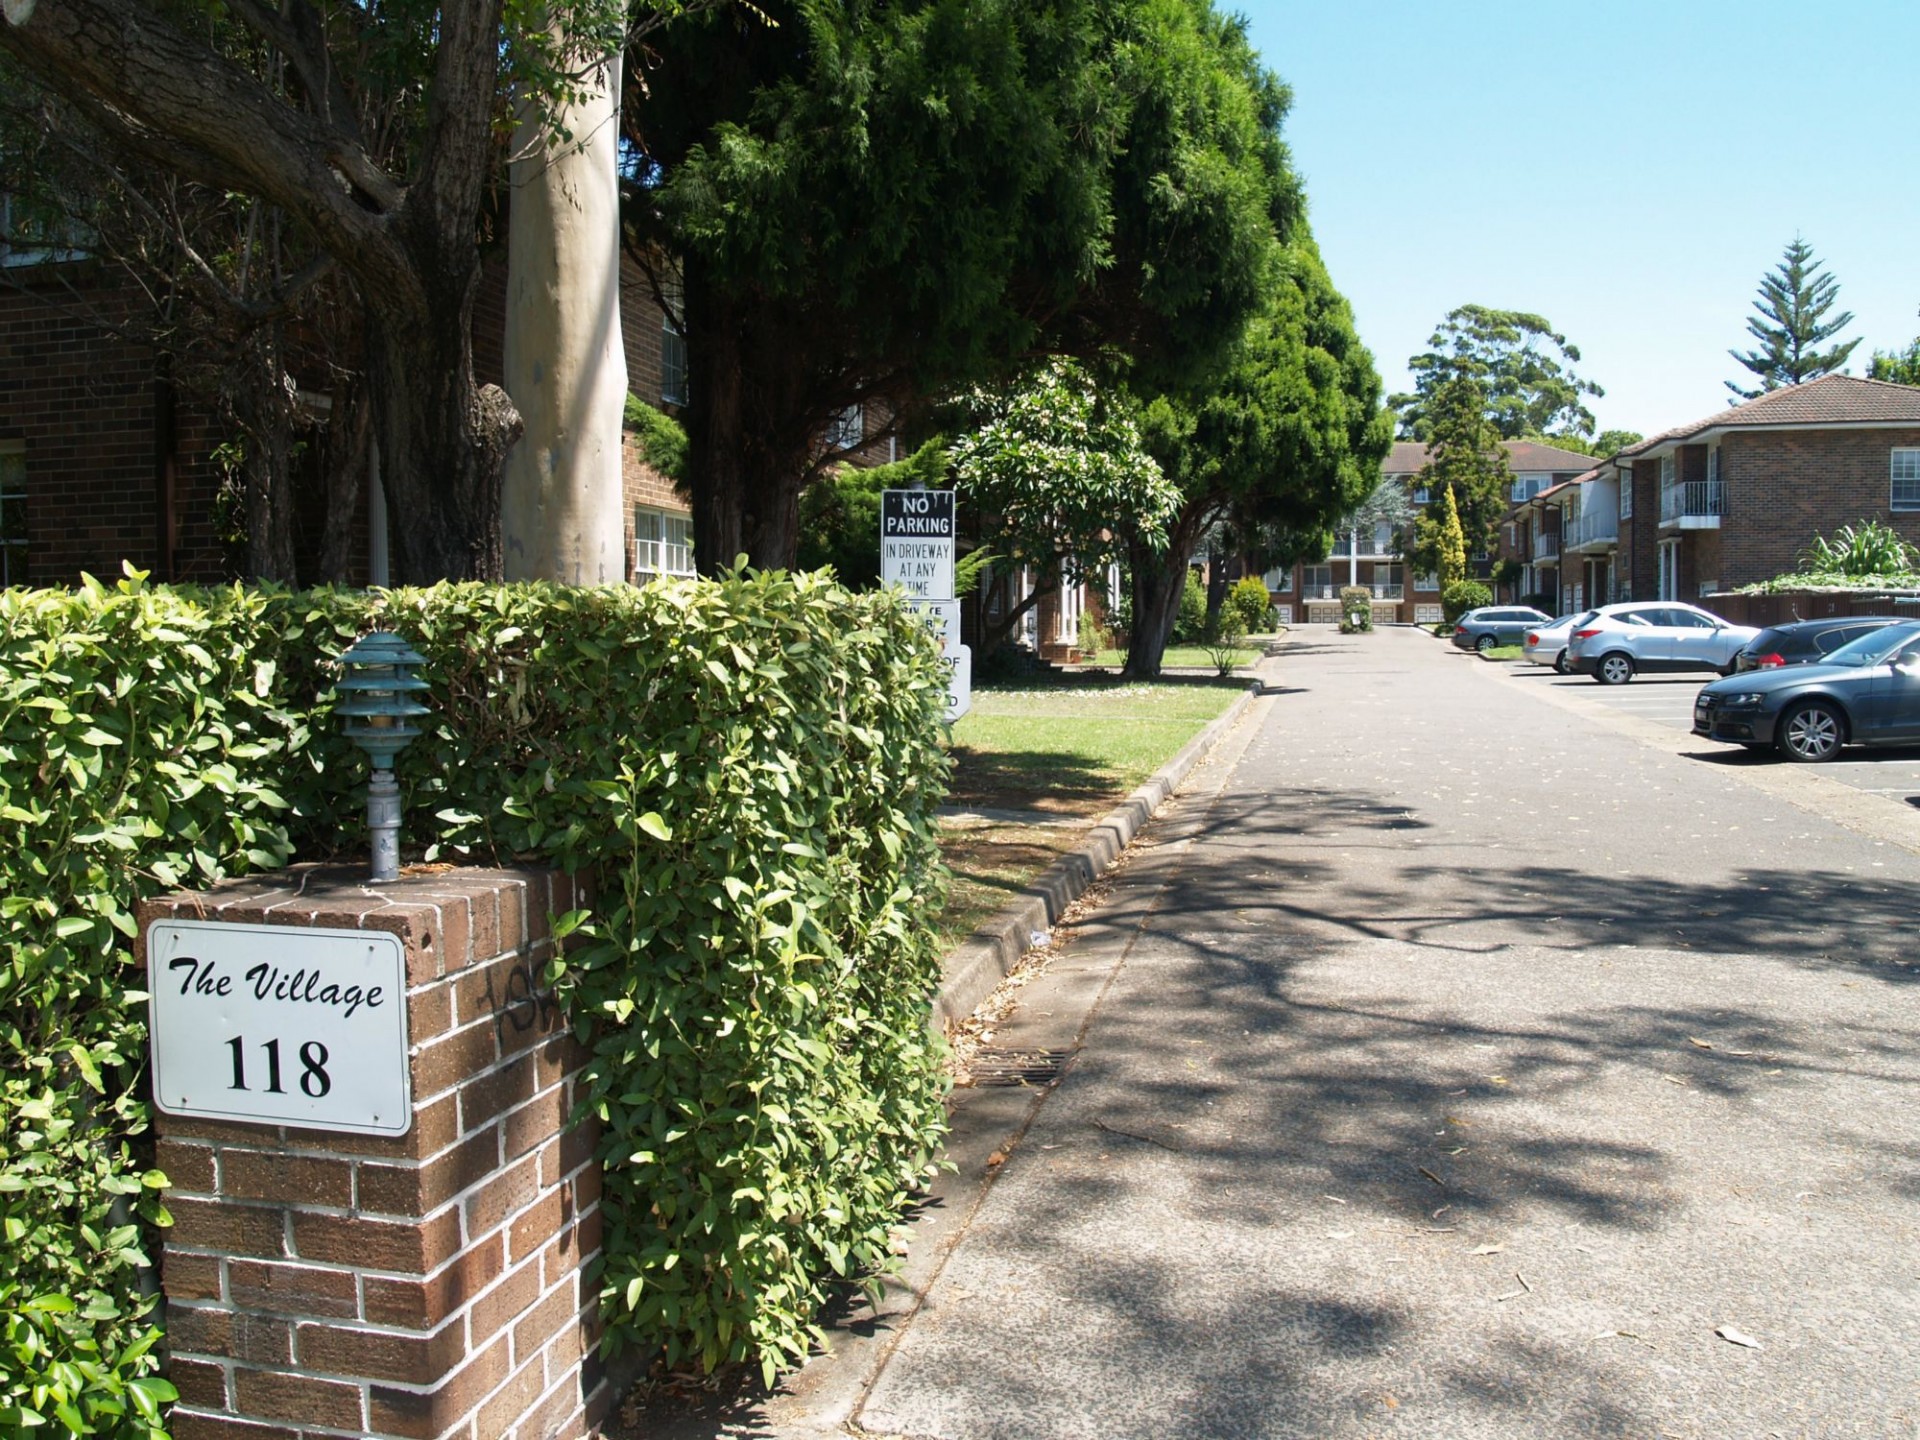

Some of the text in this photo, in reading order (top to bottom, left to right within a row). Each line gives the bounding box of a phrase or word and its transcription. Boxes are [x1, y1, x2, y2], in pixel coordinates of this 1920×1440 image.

[903, 498, 929, 513] NO
[887, 517, 949, 533] PARKING
[886, 543, 950, 558] IN DRIVEWAY
[900, 562, 936, 577] AT ANY
[907, 581, 929, 596] TIME
[169, 957, 384, 1018] The Village
[224, 1035, 331, 1098] 118
